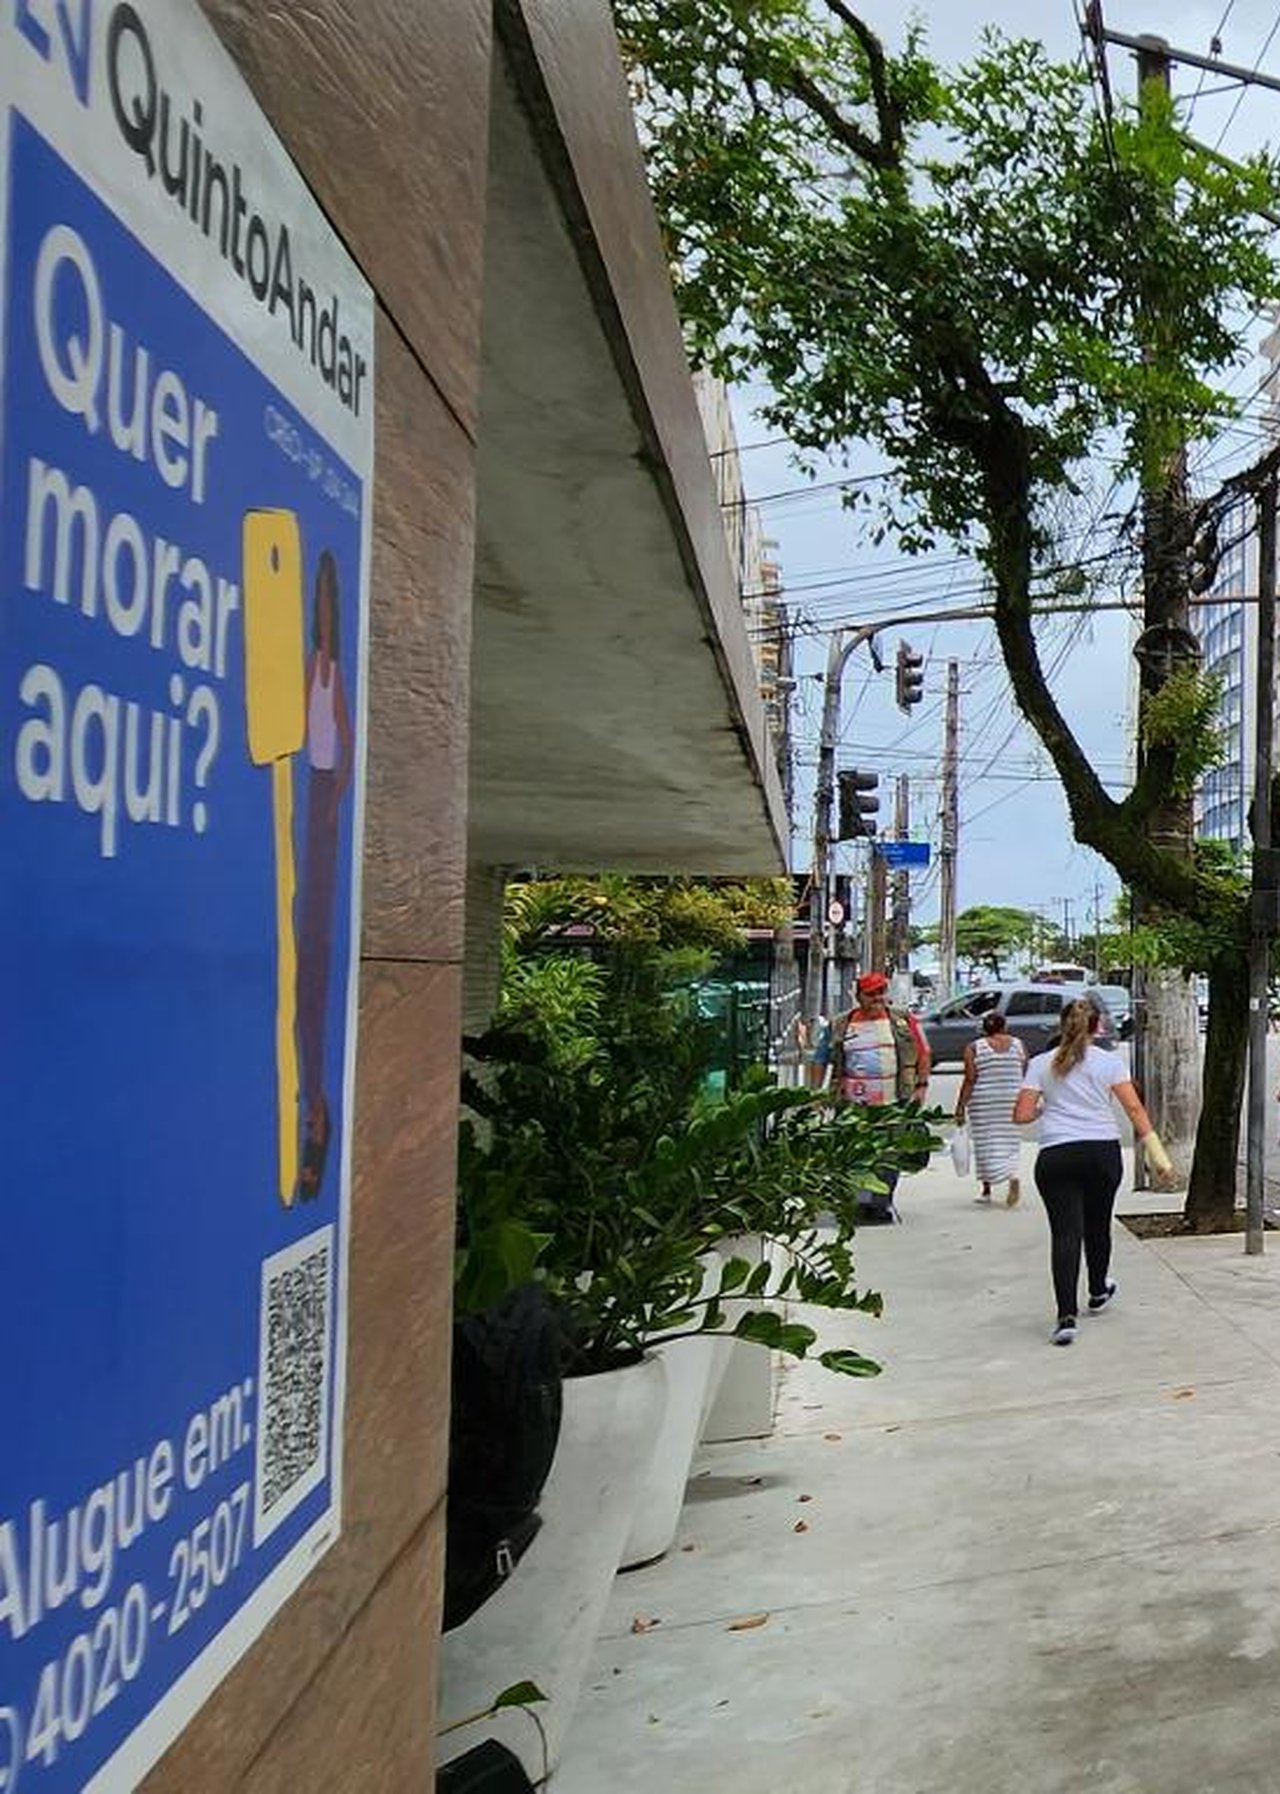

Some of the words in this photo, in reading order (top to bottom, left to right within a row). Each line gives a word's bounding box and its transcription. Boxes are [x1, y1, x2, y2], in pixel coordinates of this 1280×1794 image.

[107, 2, 367, 418] QuintoAndar
[35, 224, 218, 504] Quer
[25, 457, 239, 679] morar
[15, 664, 219, 858] aqui?
[0, 1438, 177, 1640] Alugue
[183, 1376, 254, 1490] em:
[25, 1482, 253, 1767] 4020-2507
